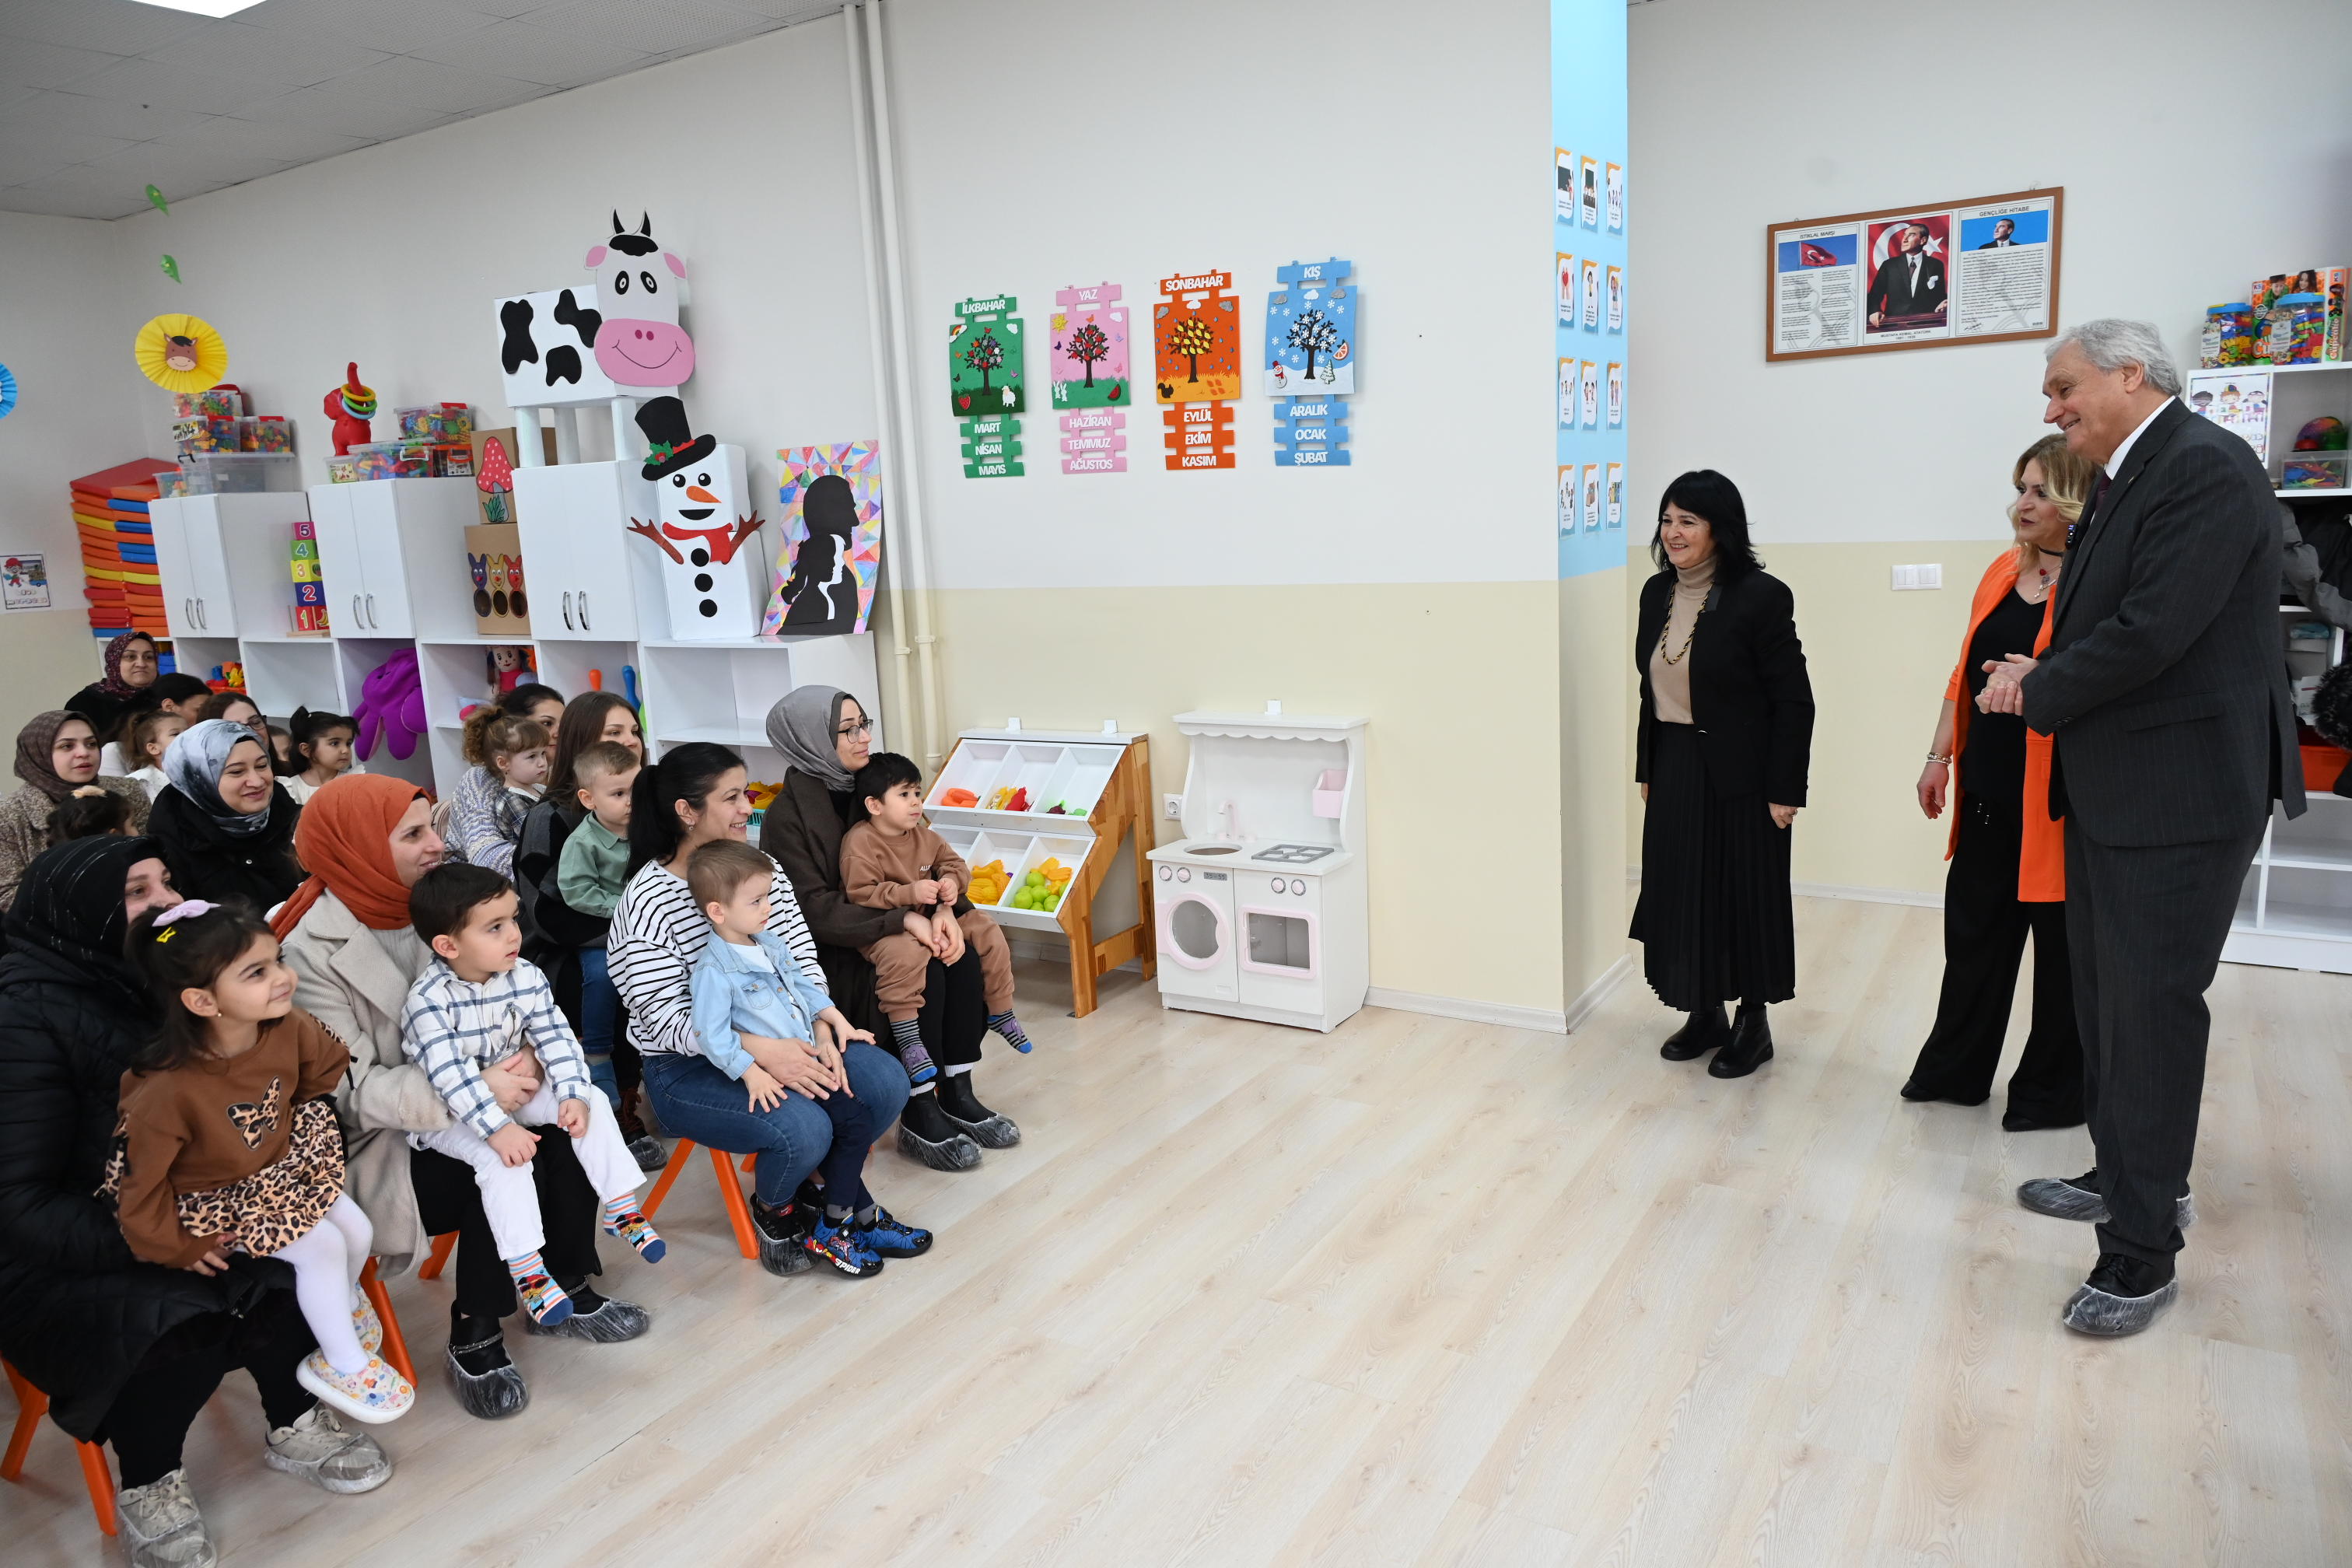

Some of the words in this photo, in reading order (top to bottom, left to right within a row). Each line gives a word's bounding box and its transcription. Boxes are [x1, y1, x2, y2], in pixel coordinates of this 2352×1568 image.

[1304, 265, 1321, 280] KIŞ
[1165, 275, 1223, 292] SONBAHAR
[1078, 289, 1098, 301] YAZ
[962, 299, 1006, 314] İLKBAHAR
[1183, 409, 1213, 422] EYLÜL
[1290, 404, 1328, 417] ARALIK
[974, 422, 1001, 433] MART
[1069, 415, 1111, 429] HAZİRAN
[1185, 431, 1212, 445] EKİM
[1294, 429, 1327, 441] OCAK
[975, 443, 1002, 456] NİSAN
[1068, 437, 1111, 450] TEMMUZ
[1069, 457, 1113, 471] AĞUSTOS
[1181, 455, 1216, 467] KASIM
[1294, 451, 1328, 467] ŞUBAT
[978, 464, 1006, 476] MAYIS
[299, 524, 311, 537] 5
[296, 542, 309, 558] 4
[297, 563, 306, 578] 3
[303, 585, 317, 602] 2
[300, 609, 309, 629] 1
[835, 1258, 861, 1275] SPIDER
